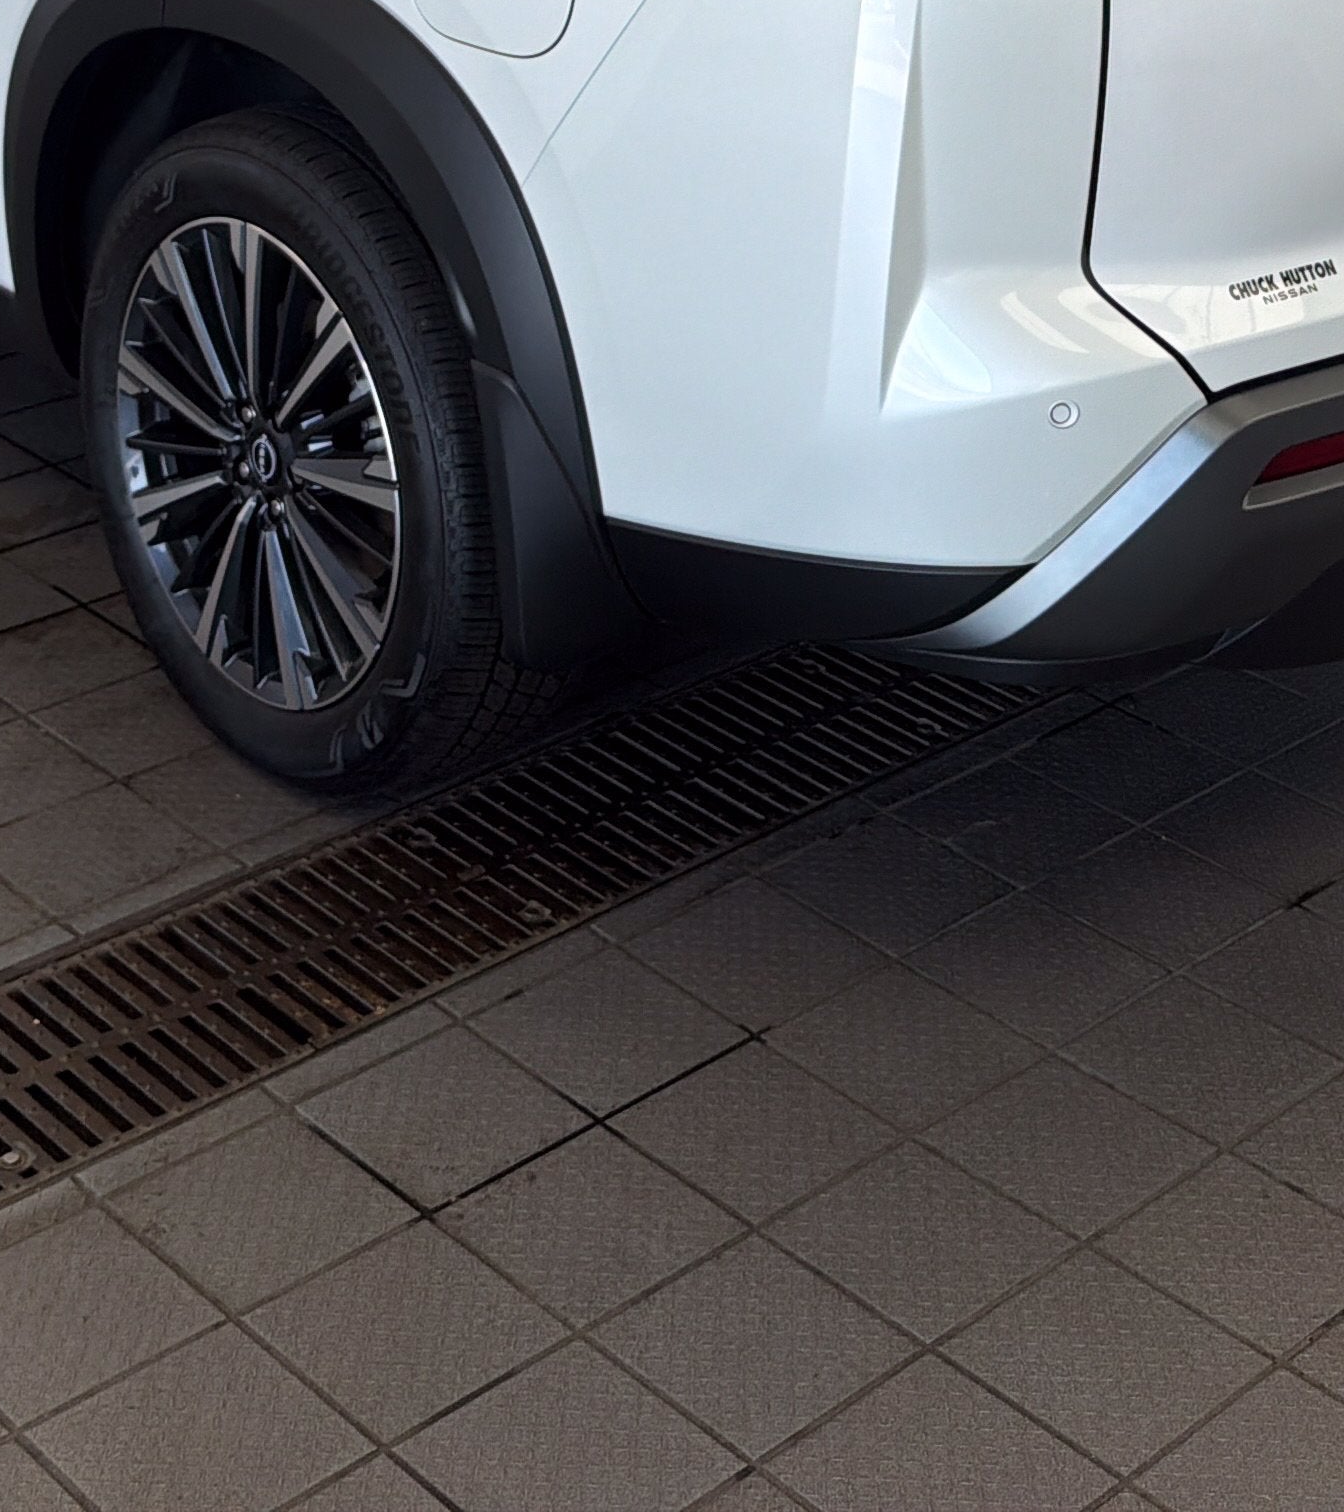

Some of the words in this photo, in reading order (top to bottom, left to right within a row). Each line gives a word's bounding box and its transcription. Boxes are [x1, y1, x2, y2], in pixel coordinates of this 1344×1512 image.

[1228, 273, 1279, 301] CHUCK
[1278, 258, 1338, 288] HUTTON
[1262, 283, 1319, 305] NISSAN
